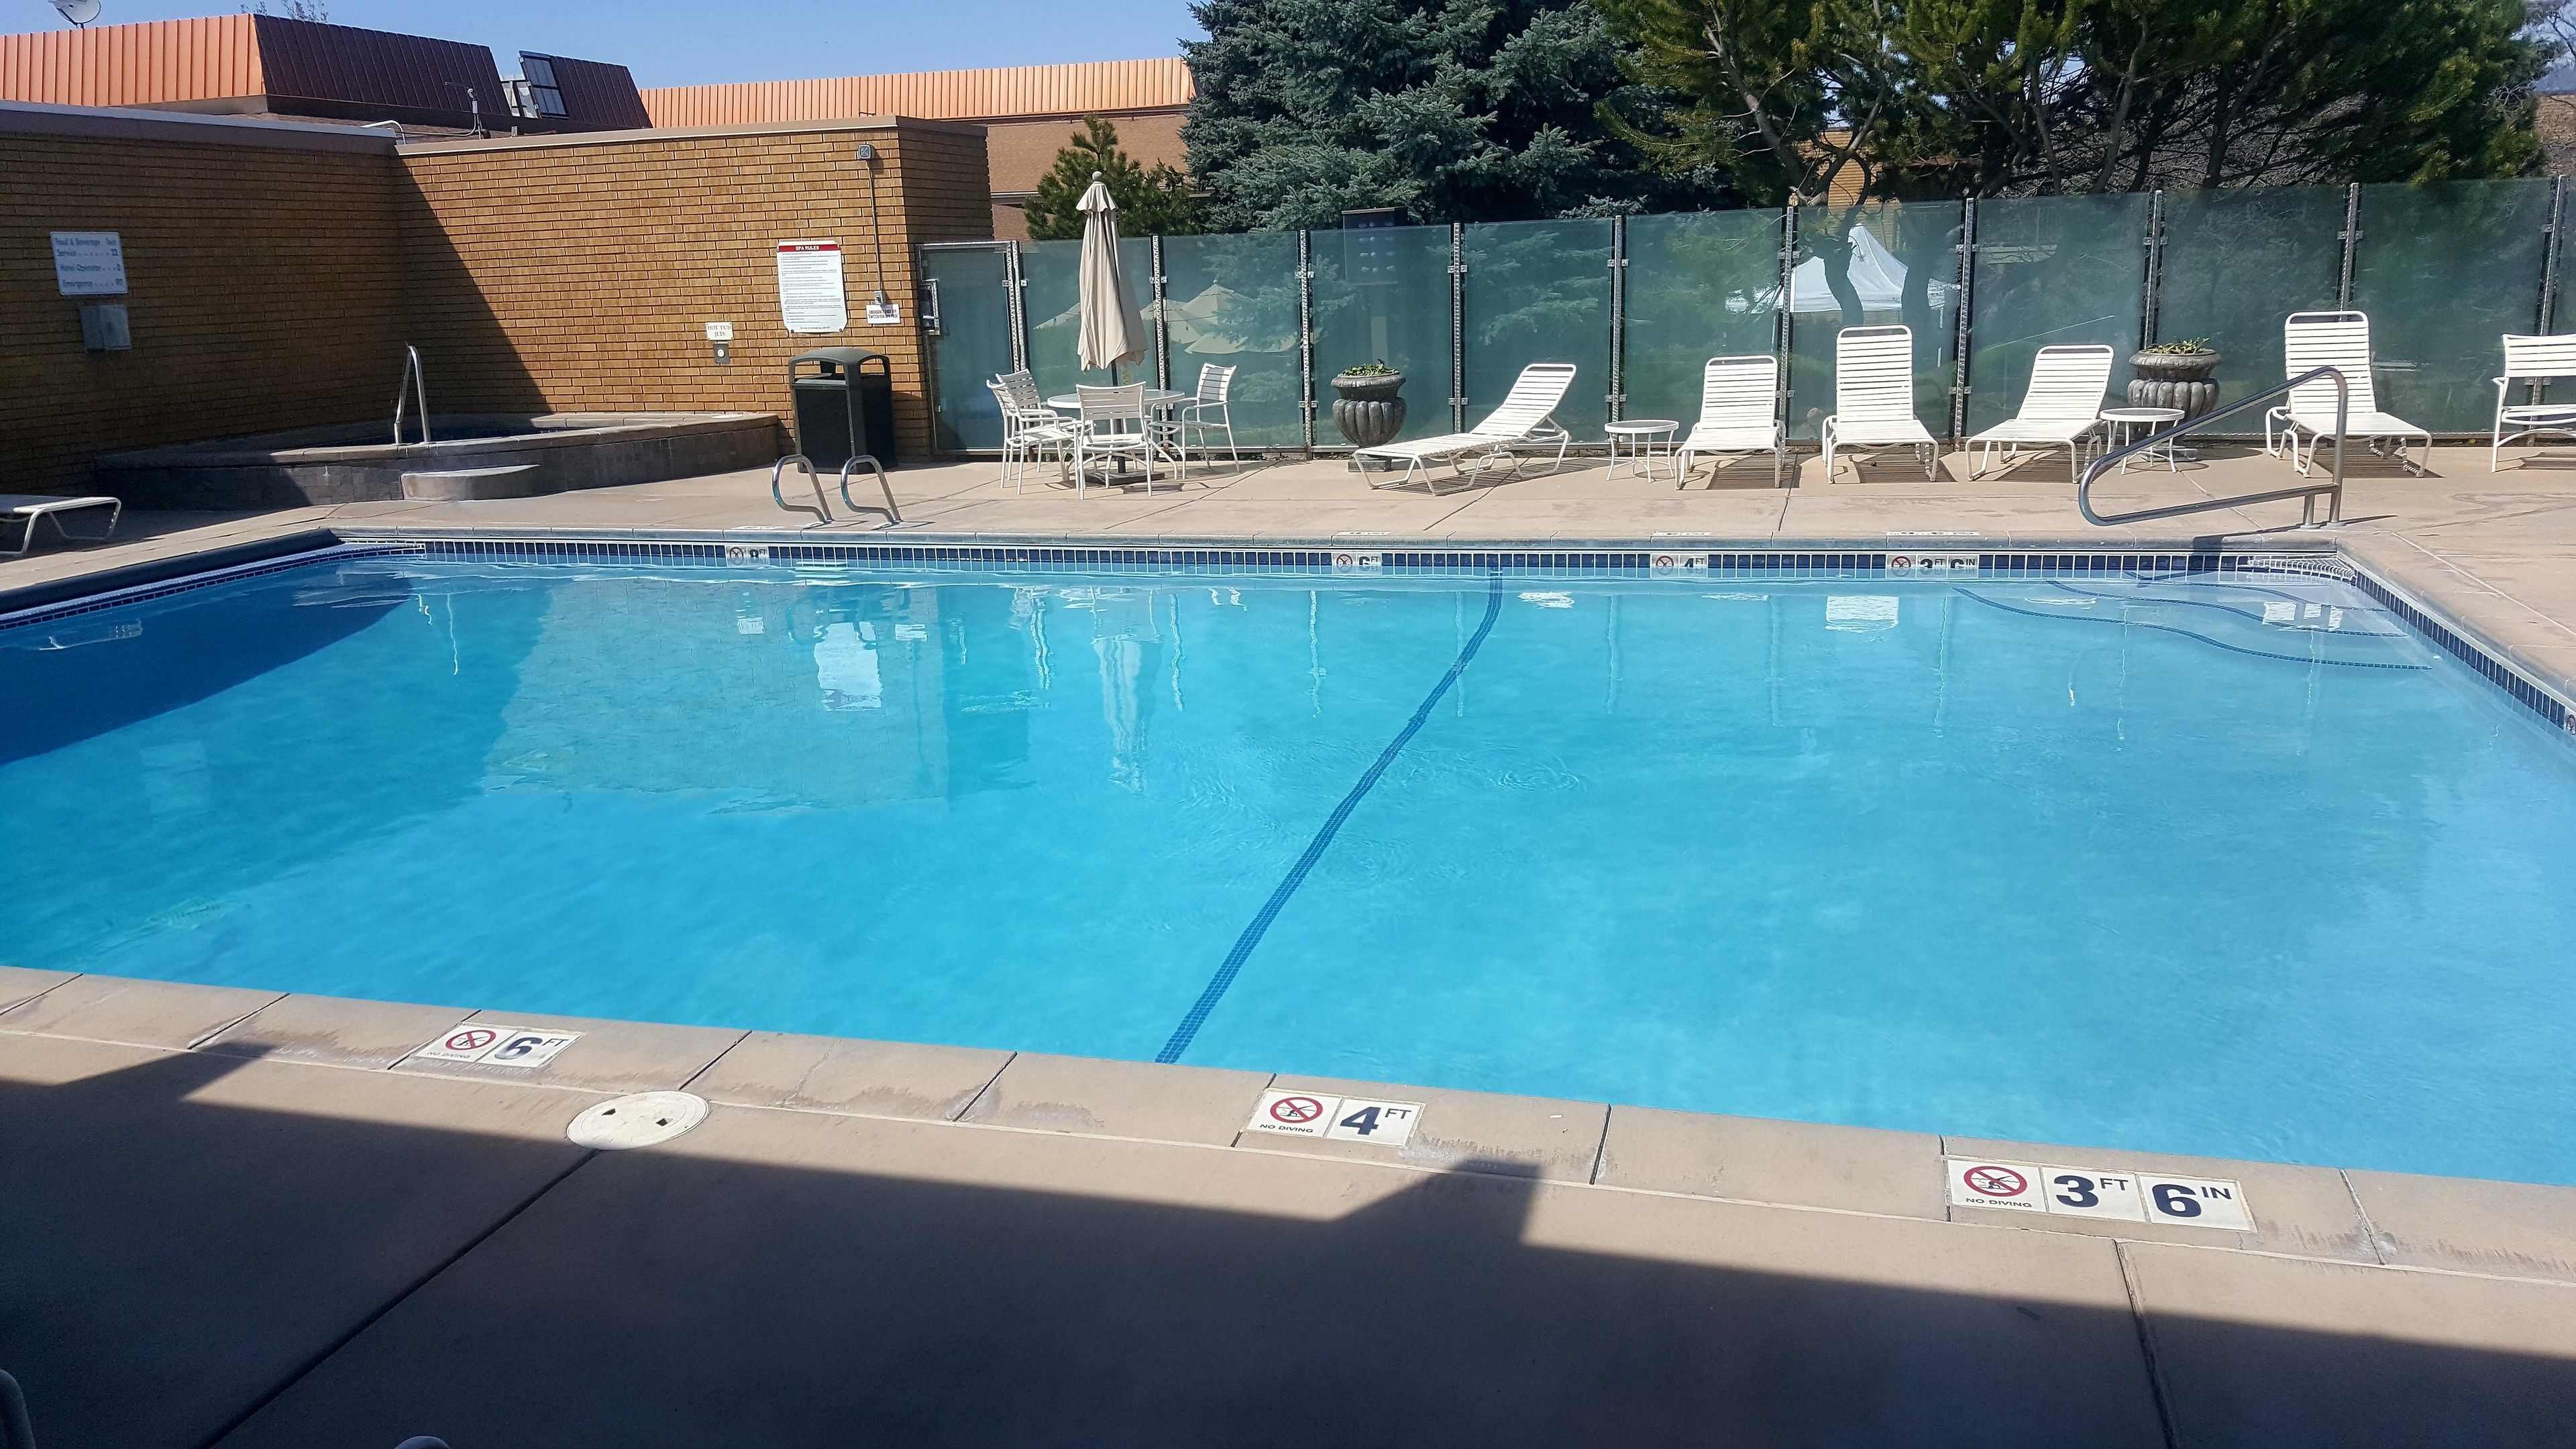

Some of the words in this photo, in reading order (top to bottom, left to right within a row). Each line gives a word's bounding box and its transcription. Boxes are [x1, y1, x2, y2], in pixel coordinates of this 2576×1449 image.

[1934, 558, 1945, 566] FT
[1966, 558, 1976, 566] IN
[494, 1036, 543, 1061] 6
[541, 1038, 570, 1047] FT
[1278, 1126, 1313, 1134] DIVING
[1339, 1106, 1382, 1136] 4
[1384, 1108, 1412, 1120] FT
[1966, 1197, 1985, 1205] NO
[1988, 1199, 2033, 1208] DIVING
[2053, 1175, 2099, 1208] 3
[2099, 1177, 2129, 1191] FT
[2151, 1183, 2202, 1218] 6
[2200, 1185, 2233, 1200] IN
